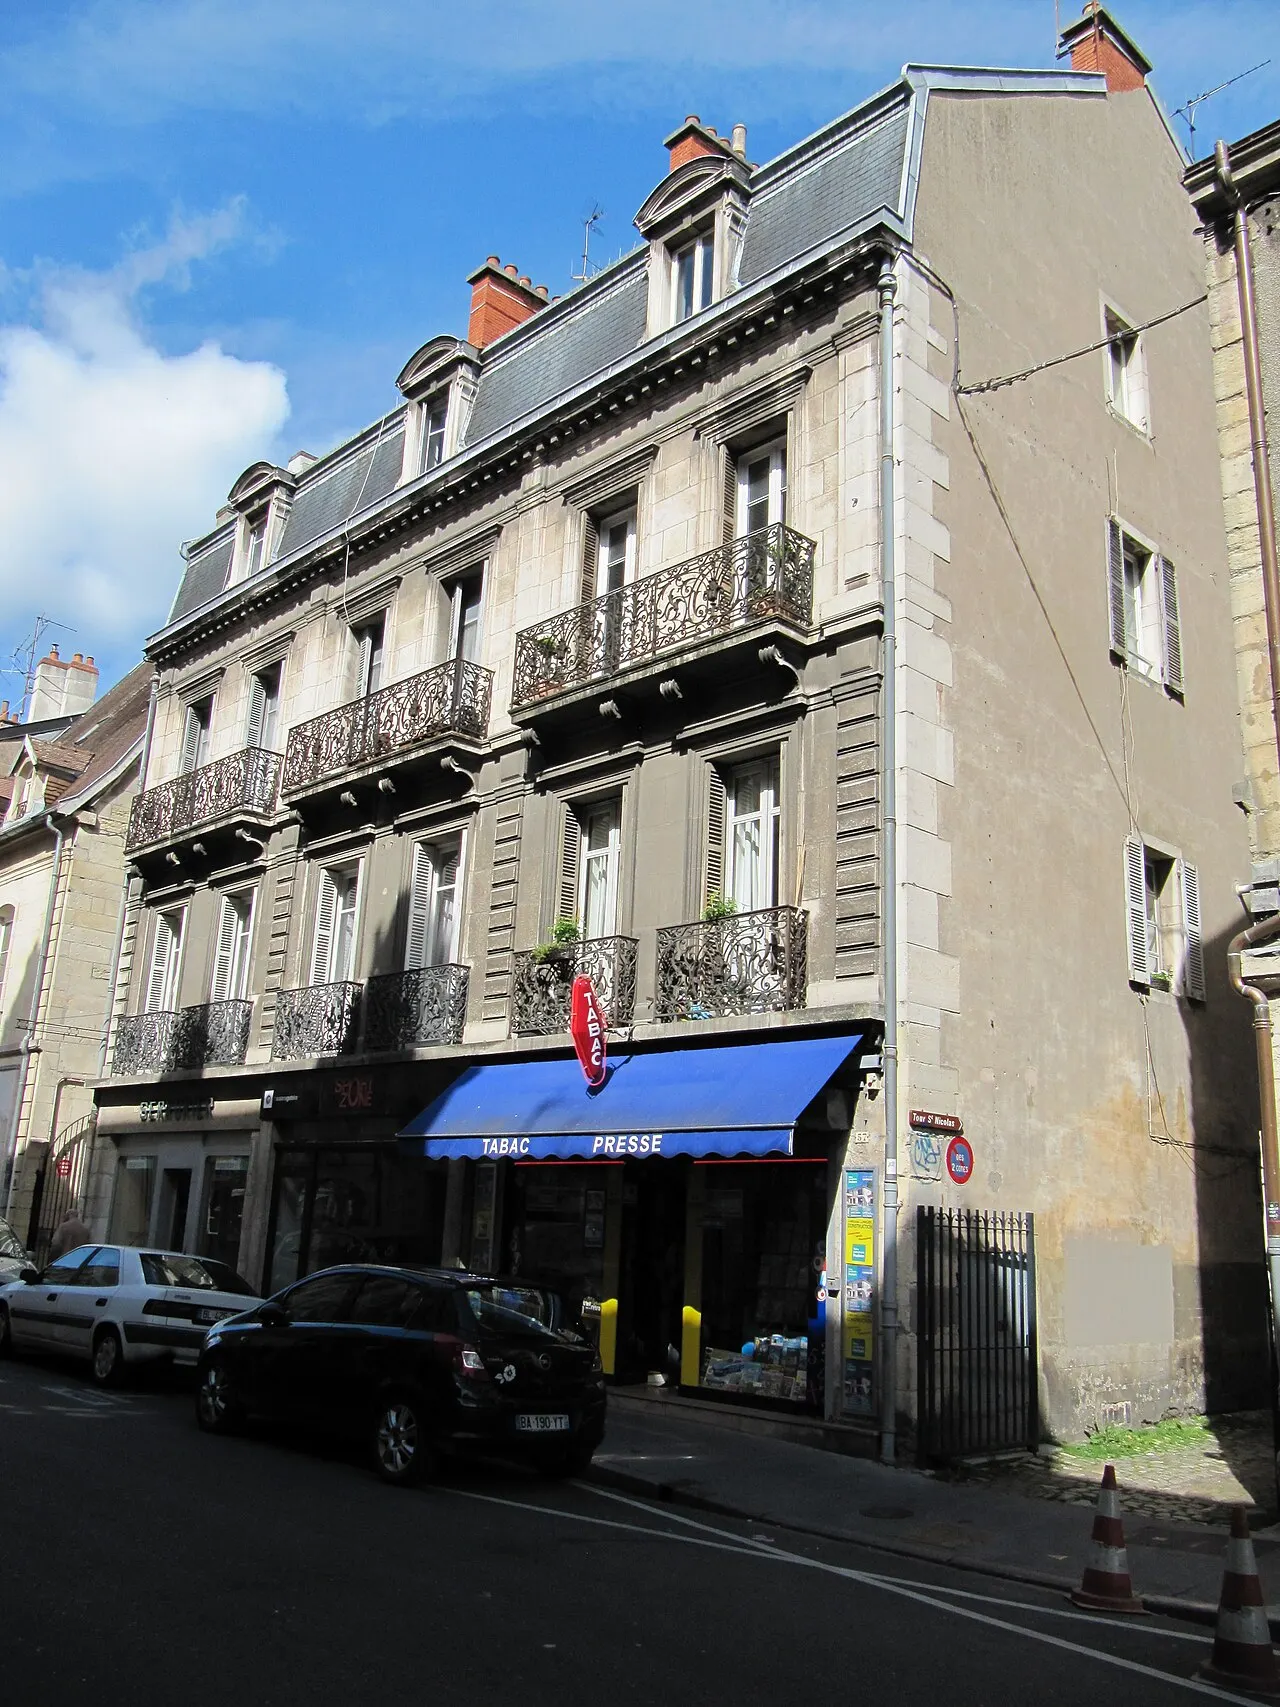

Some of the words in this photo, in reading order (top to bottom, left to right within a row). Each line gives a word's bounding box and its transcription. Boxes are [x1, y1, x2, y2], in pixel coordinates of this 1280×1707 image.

[583, 992, 602, 1066] TABAC
[912, 1112, 926, 1123] Tour
[935, 1116, 956, 1127] Nicolas
[482, 1138, 531, 1154] TABAC
[592, 1134, 663, 1153] PRESSE
[857, 1132, 868, 1142] 57
